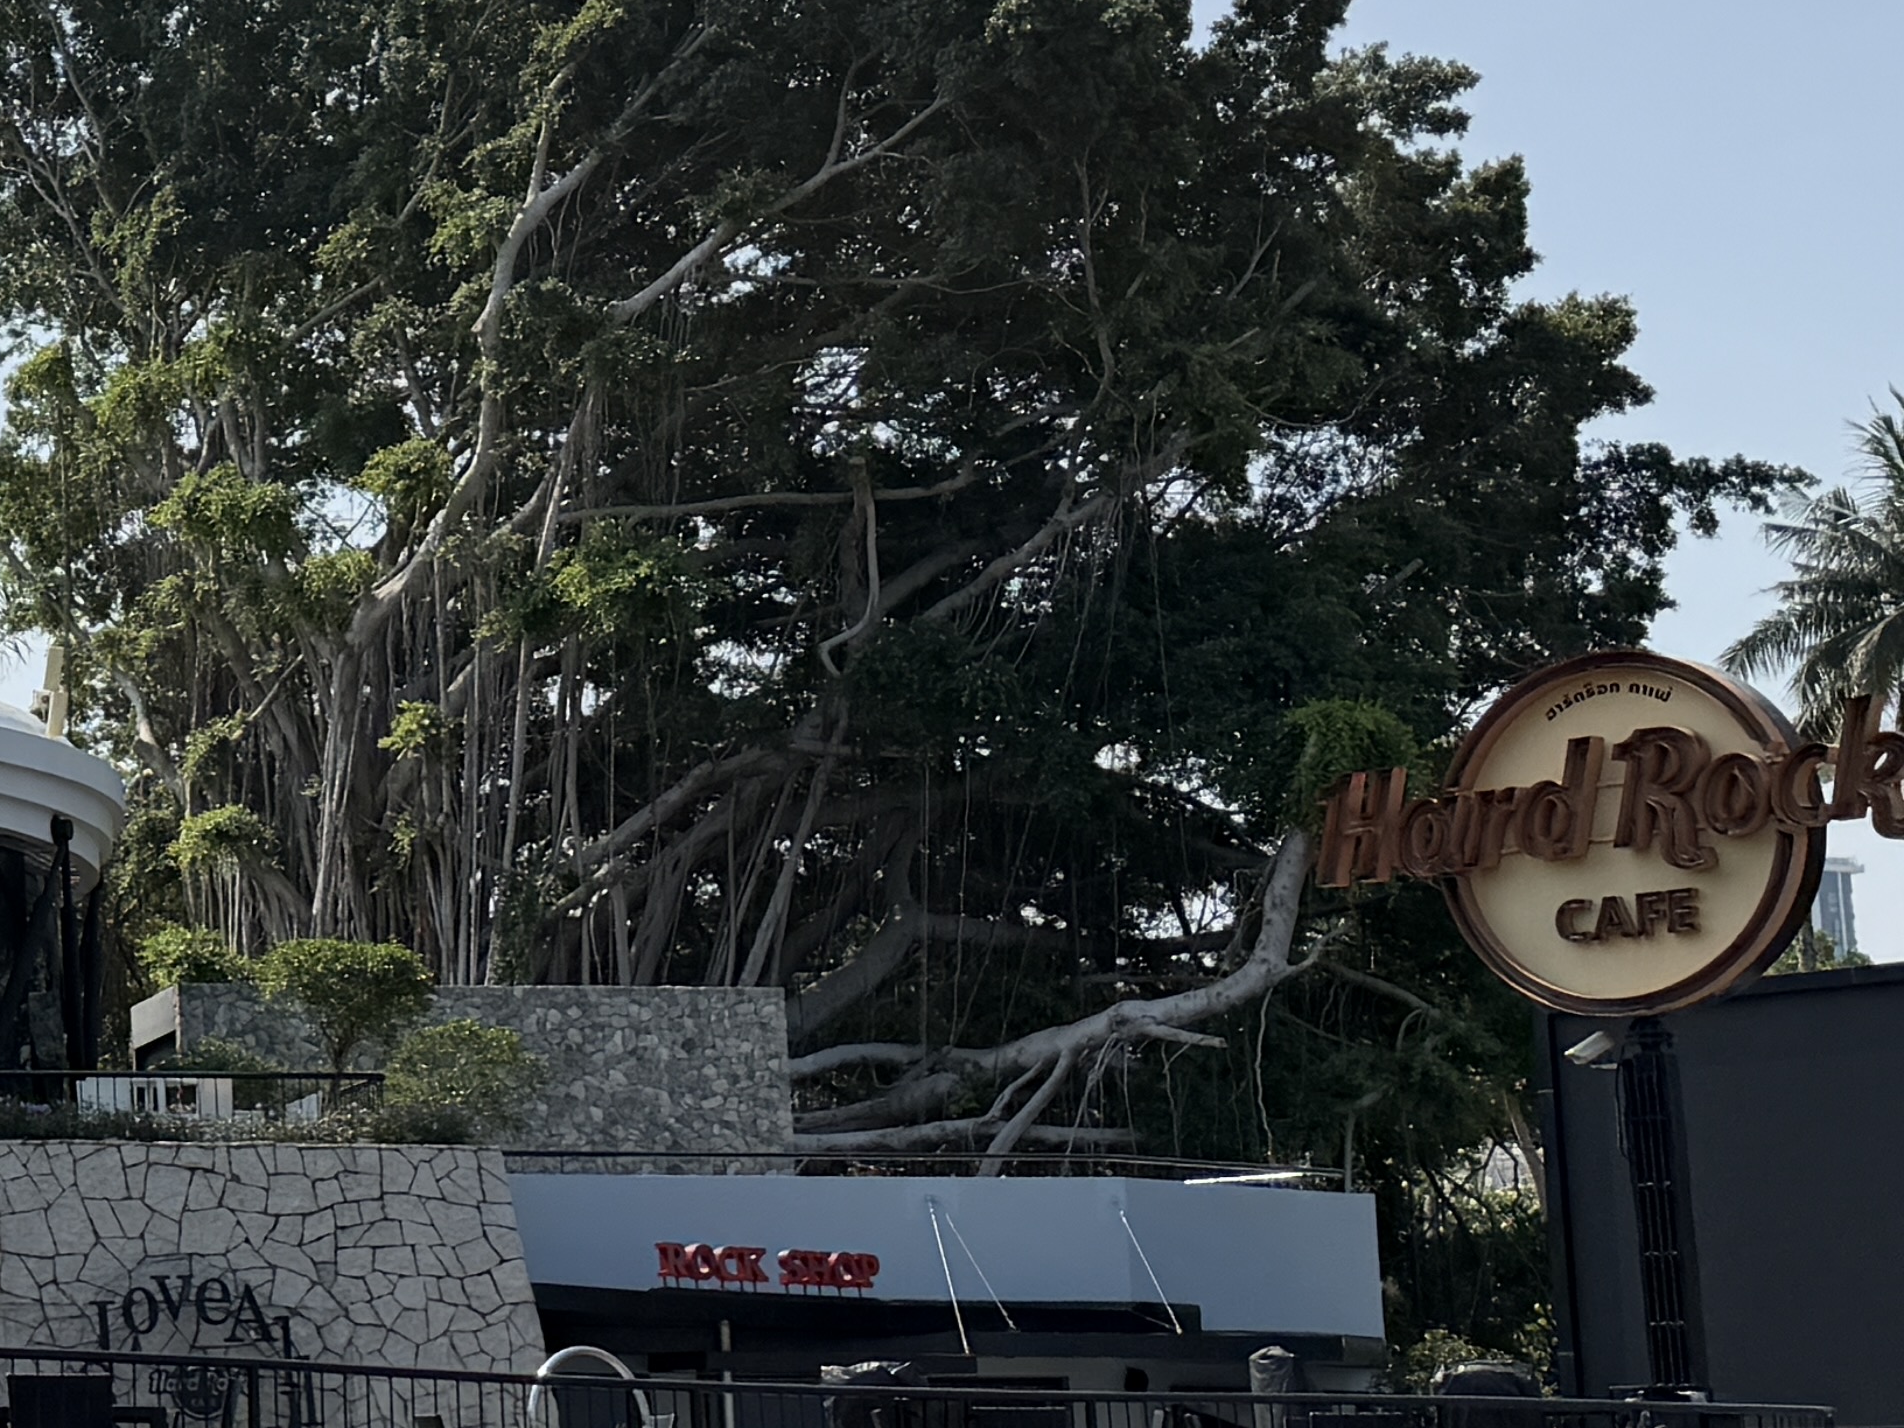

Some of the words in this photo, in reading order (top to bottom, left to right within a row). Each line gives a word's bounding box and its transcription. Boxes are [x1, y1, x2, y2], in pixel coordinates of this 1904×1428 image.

[1315, 735, 1606, 888] Hard
[1612, 694, 1904, 871] Rock
[1554, 887, 1701, 944] CAFE
[655, 1241, 769, 1283] ROCK
[777, 1248, 880, 1288] SHOP
